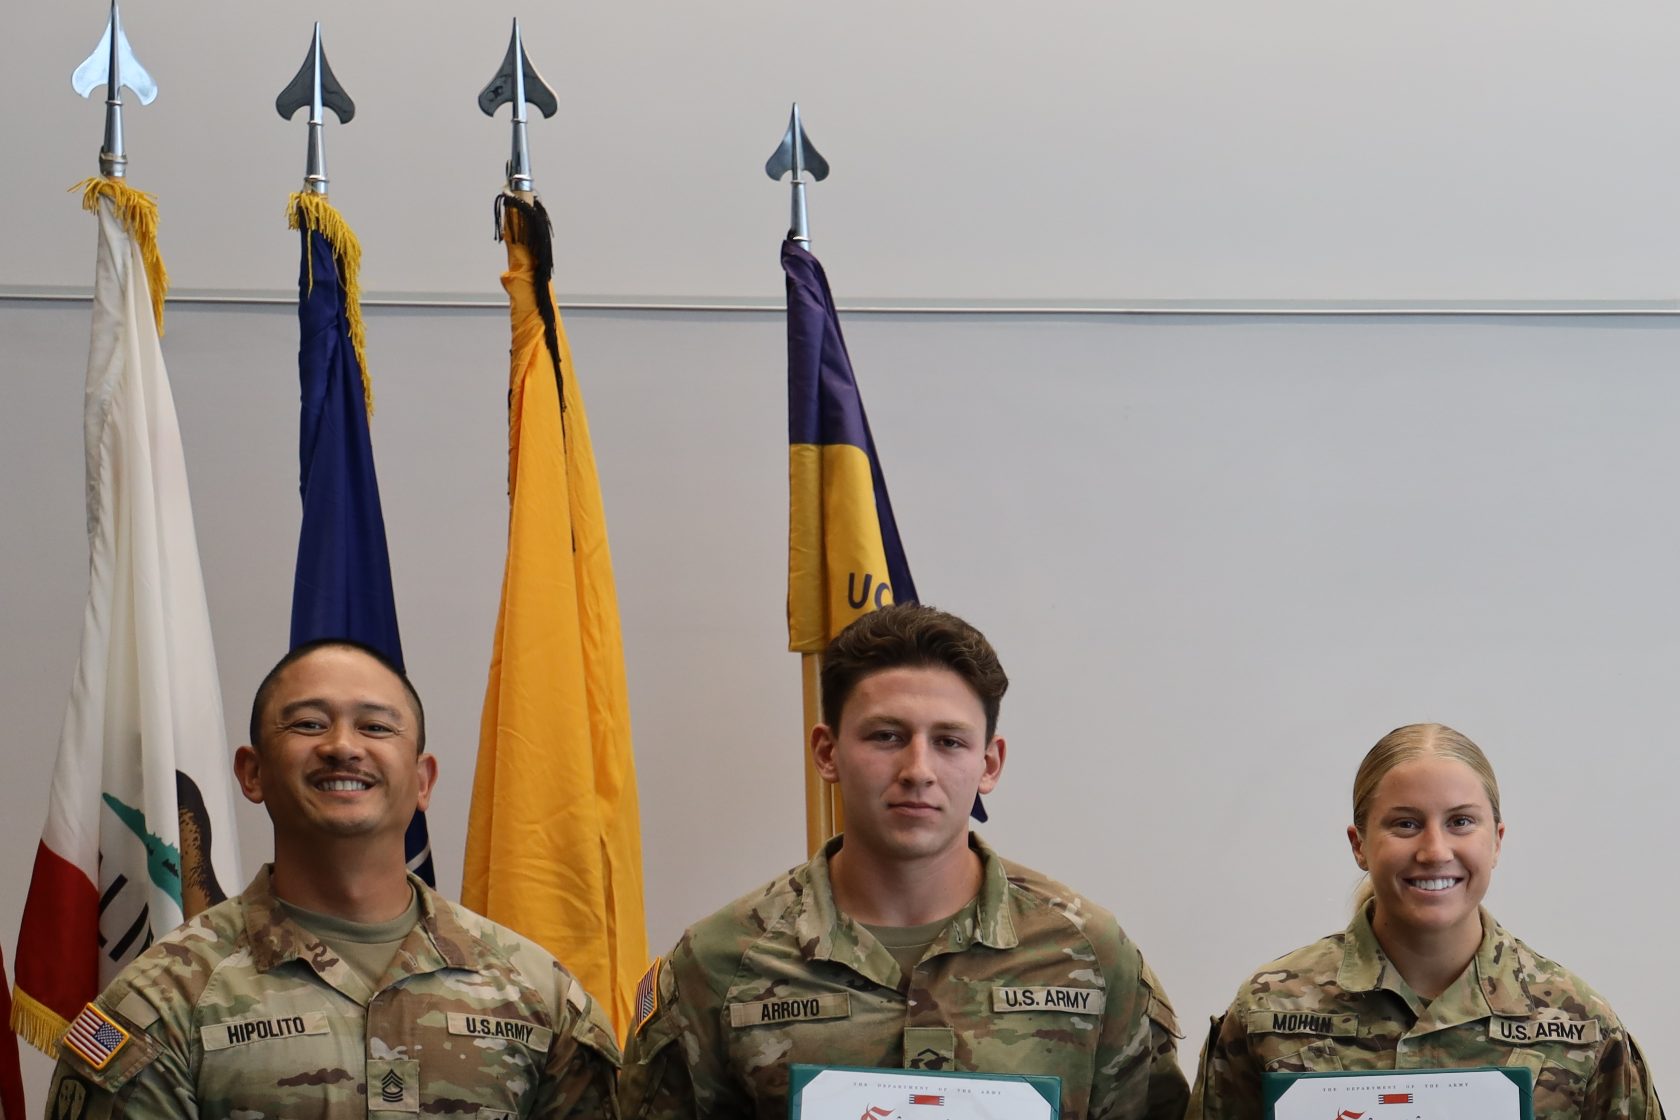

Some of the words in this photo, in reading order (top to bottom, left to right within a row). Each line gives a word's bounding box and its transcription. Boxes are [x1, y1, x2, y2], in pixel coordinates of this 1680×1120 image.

[760, 998, 820, 1020] ARROYO
[1005, 990, 1040, 1007] U.S.
[1044, 989, 1090, 1010] ARMY
[226, 1016, 306, 1045] HIPOLITO
[1272, 1014, 1333, 1033] MOHUN
[1501, 1024, 1531, 1040] U.S.
[1534, 1022, 1585, 1040] ARMY
